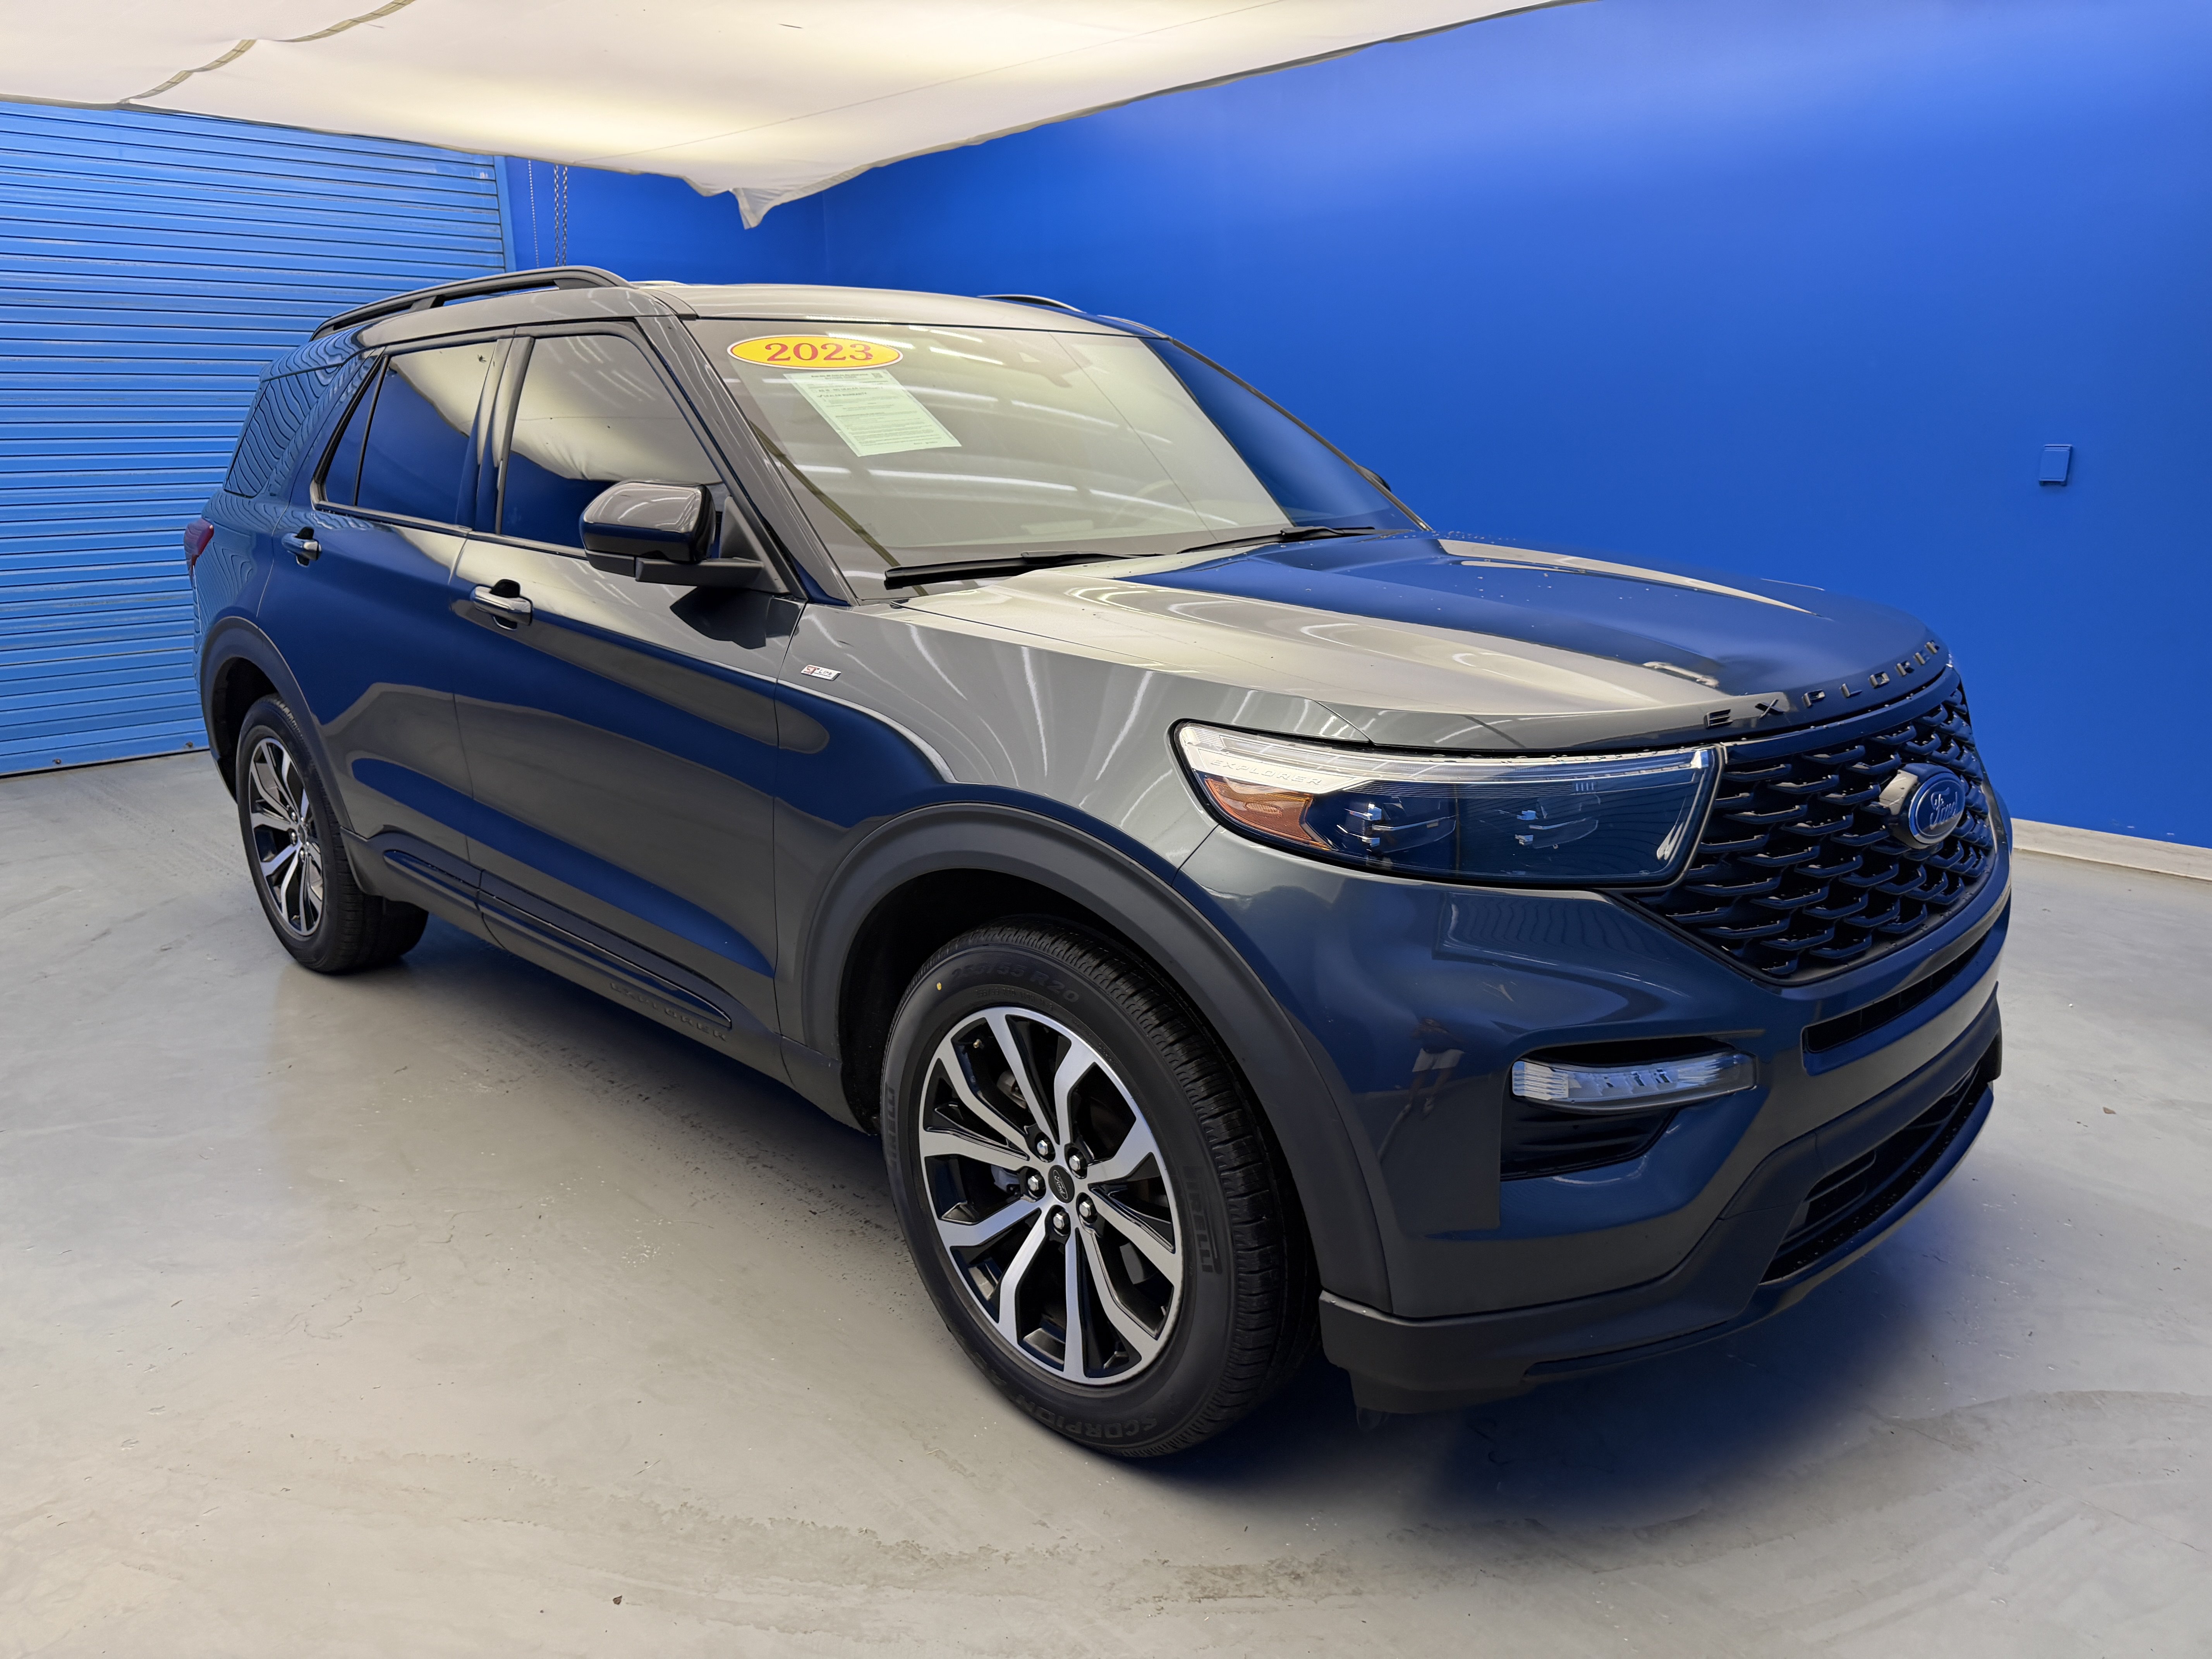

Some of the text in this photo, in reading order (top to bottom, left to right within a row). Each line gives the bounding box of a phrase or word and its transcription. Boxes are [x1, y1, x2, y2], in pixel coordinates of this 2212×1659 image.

[765, 343, 873, 361] 2023
[1705, 640, 1940, 729] EXPLORER
[1211, 760, 1322, 785] EXPLORER
[1030, 970, 1080, 1003] R20
